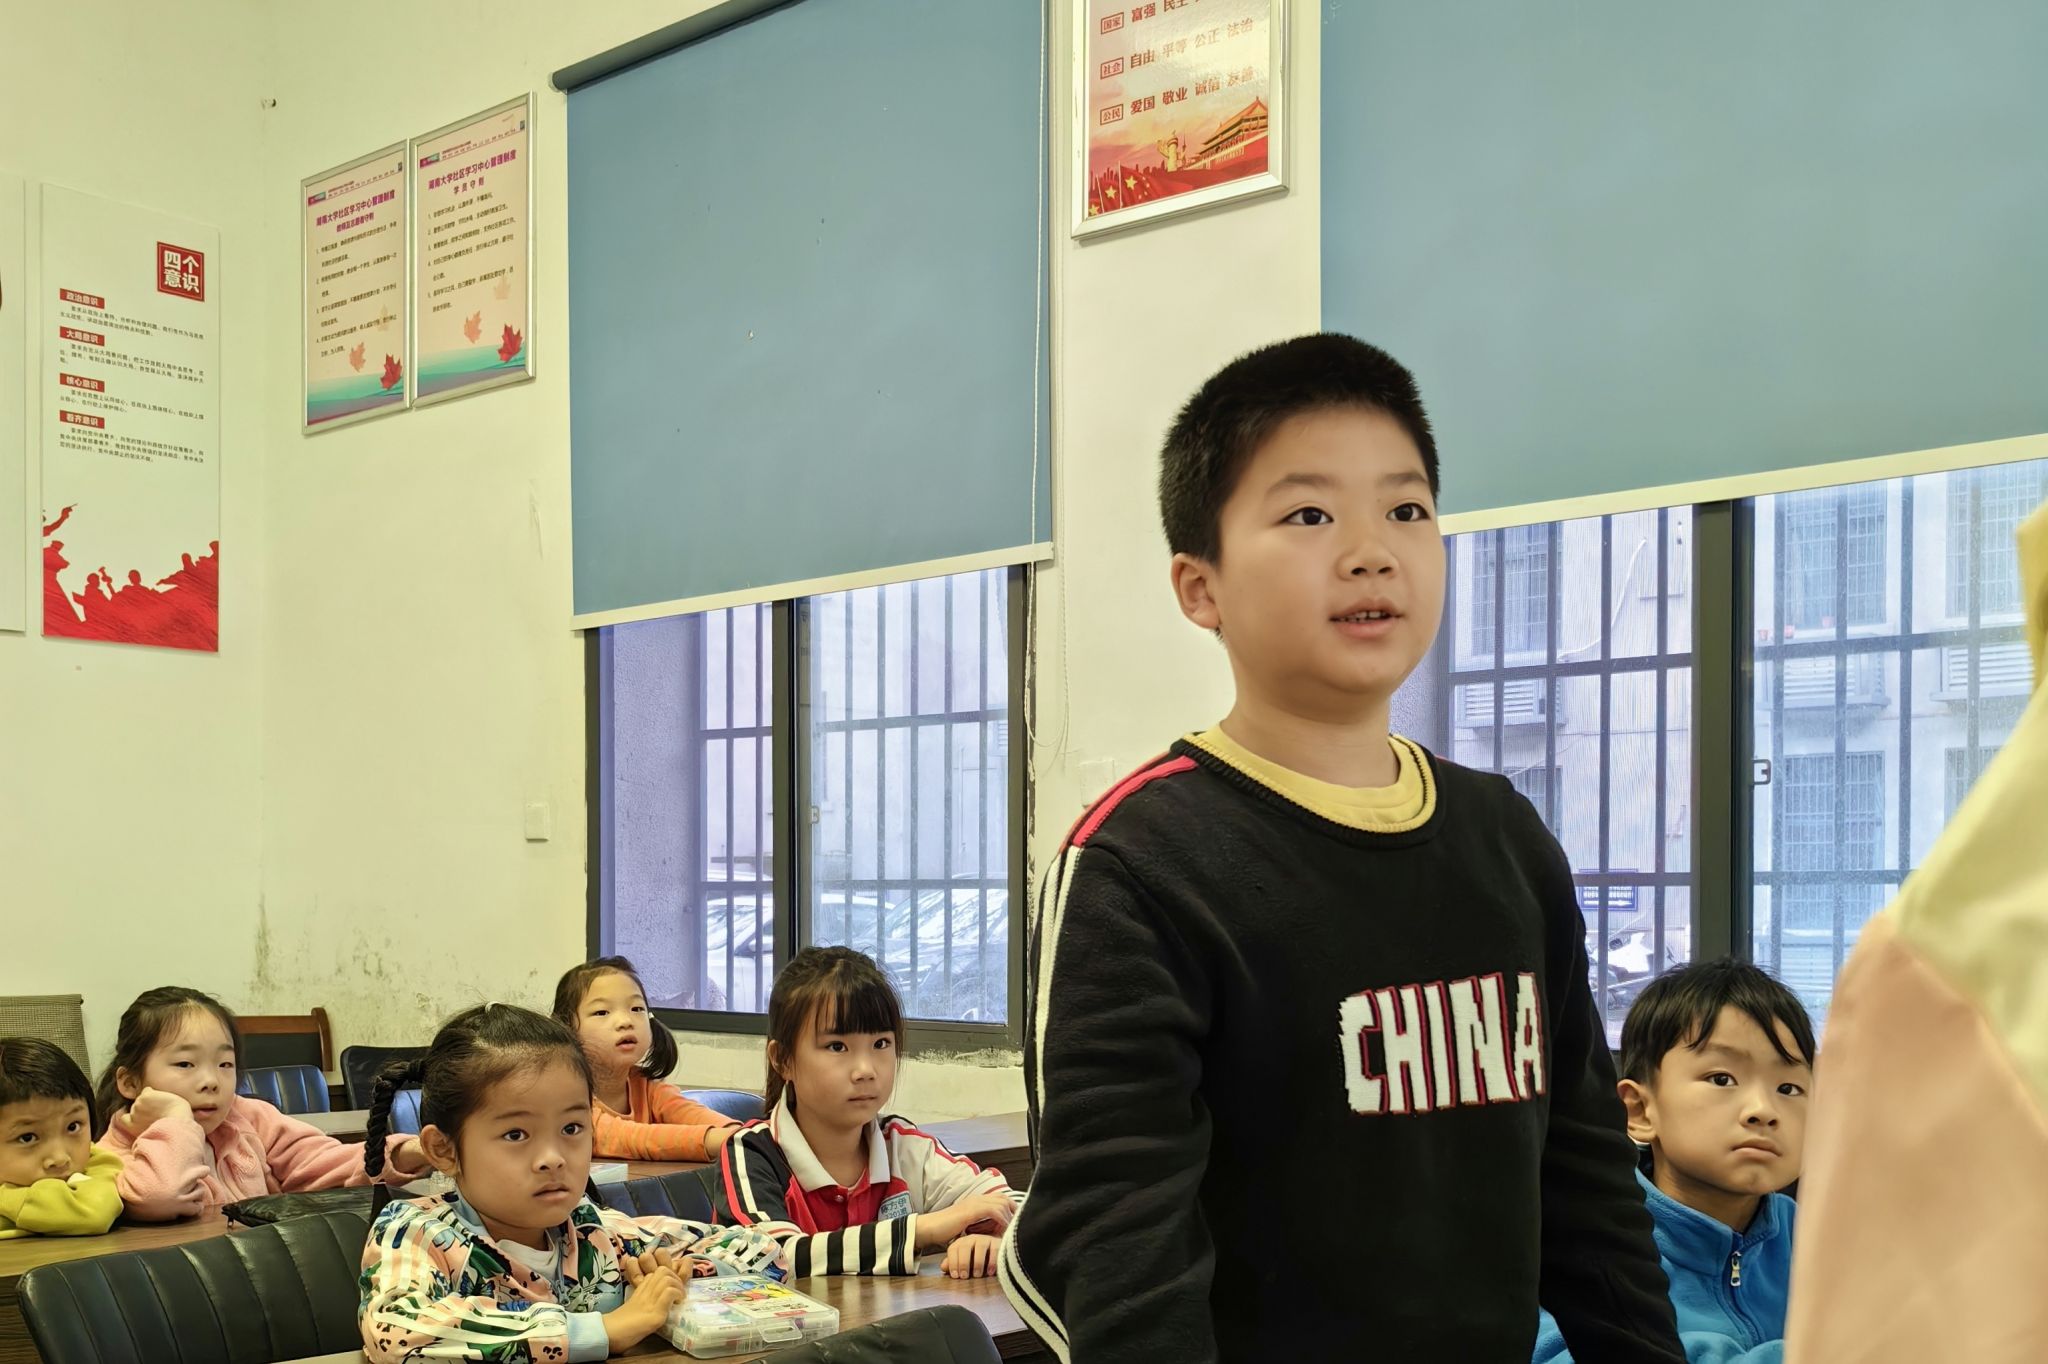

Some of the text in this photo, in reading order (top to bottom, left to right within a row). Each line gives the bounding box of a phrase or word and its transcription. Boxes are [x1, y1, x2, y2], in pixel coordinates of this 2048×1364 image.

[1103, 16, 1122, 31] 国家
[1131, 3, 1156, 22] 富强
[1103, 17, 1254, 75] 社会 自由 平等 公正 法治
[1102, 107, 1121, 122] 公民
[1130, 95, 1156, 115] 爱国
[1162, 87, 1188, 106] 敬业
[1194, 76, 1221, 96] 诚信
[163, 250, 200, 274] 四个
[163, 268, 201, 294] 意识
[65, 291, 99, 307] 政治意识
[65, 329, 99, 345] 大局意识
[65, 375, 99, 391] 核心意识
[65, 413, 99, 428] 看齐意识
[1338, 971, 1546, 1116] CHINA
